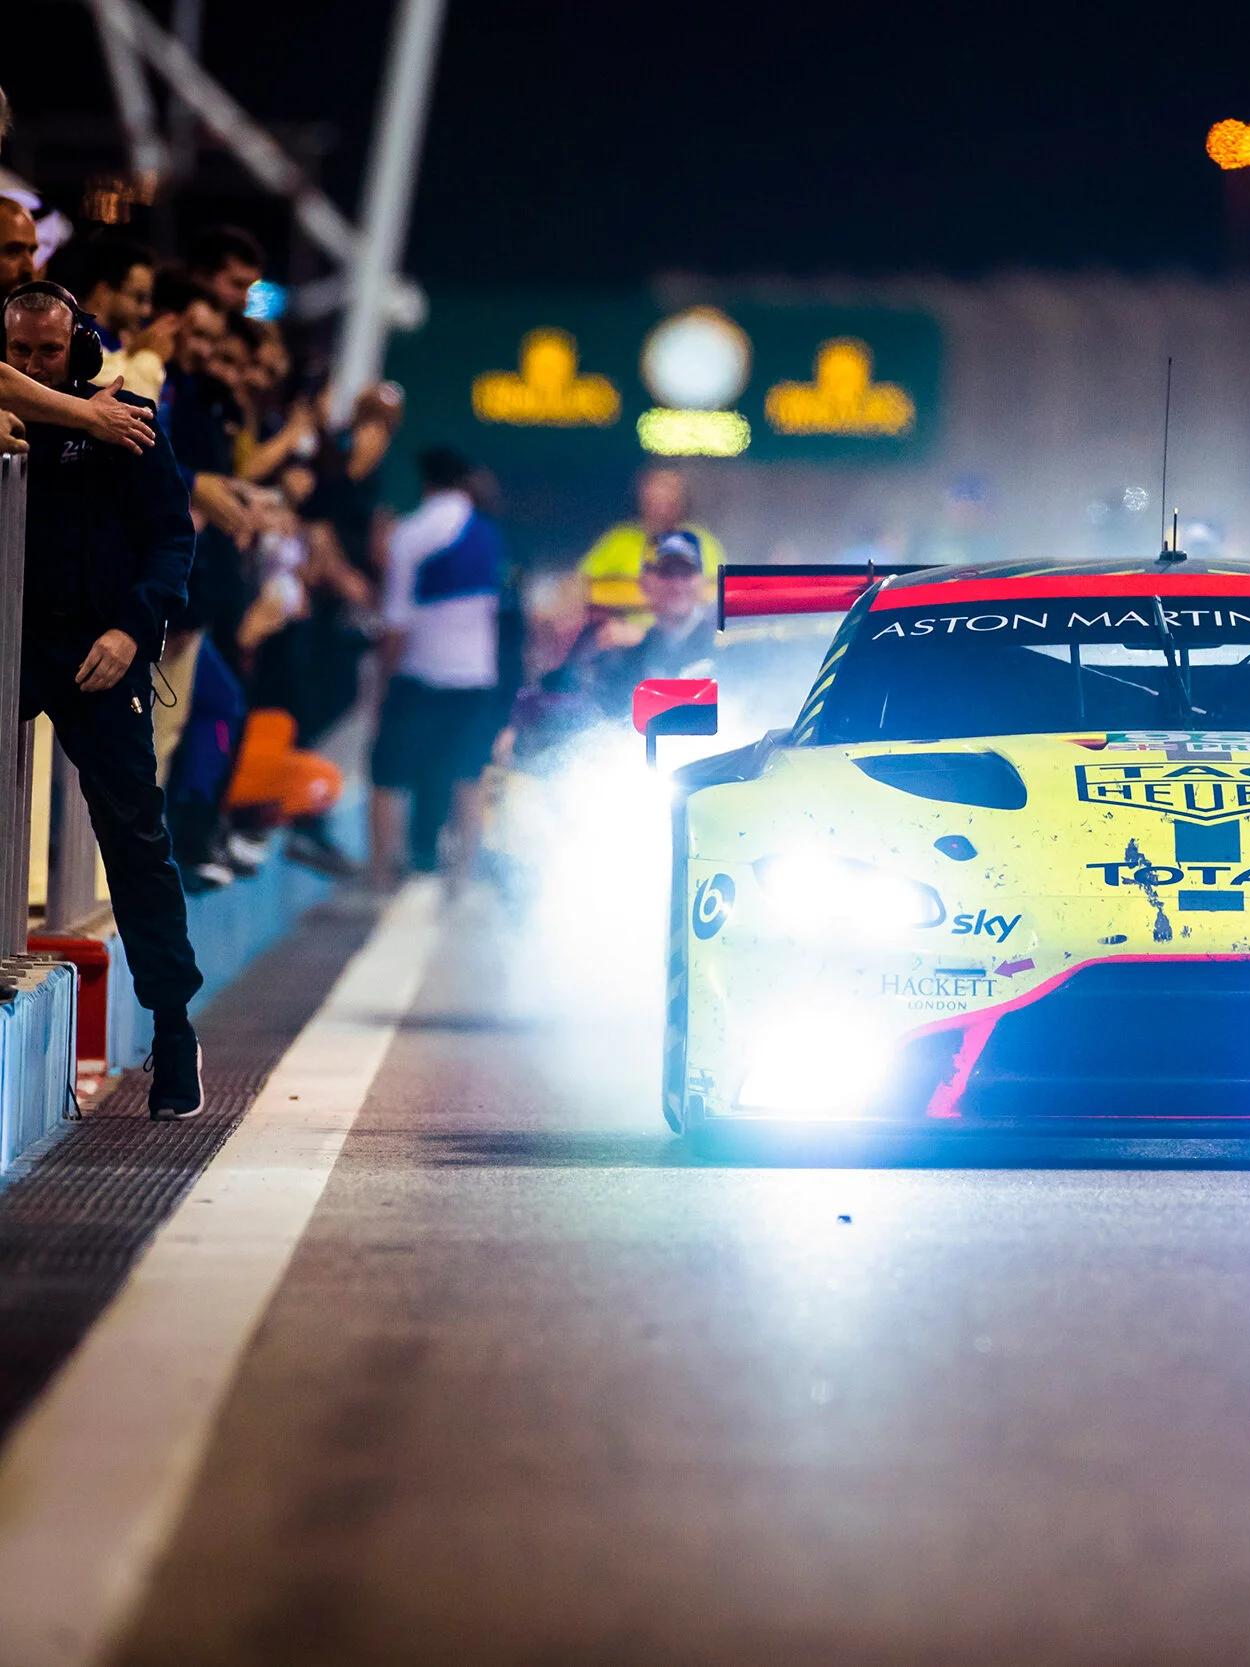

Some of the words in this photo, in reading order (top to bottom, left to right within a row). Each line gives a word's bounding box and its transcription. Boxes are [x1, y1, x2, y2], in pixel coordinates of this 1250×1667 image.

[872, 613, 1048, 641] ASTON
[951, 909, 1022, 943] sky
[881, 974, 997, 997] HACKETT
[907, 1000, 967, 1011] LONDON
